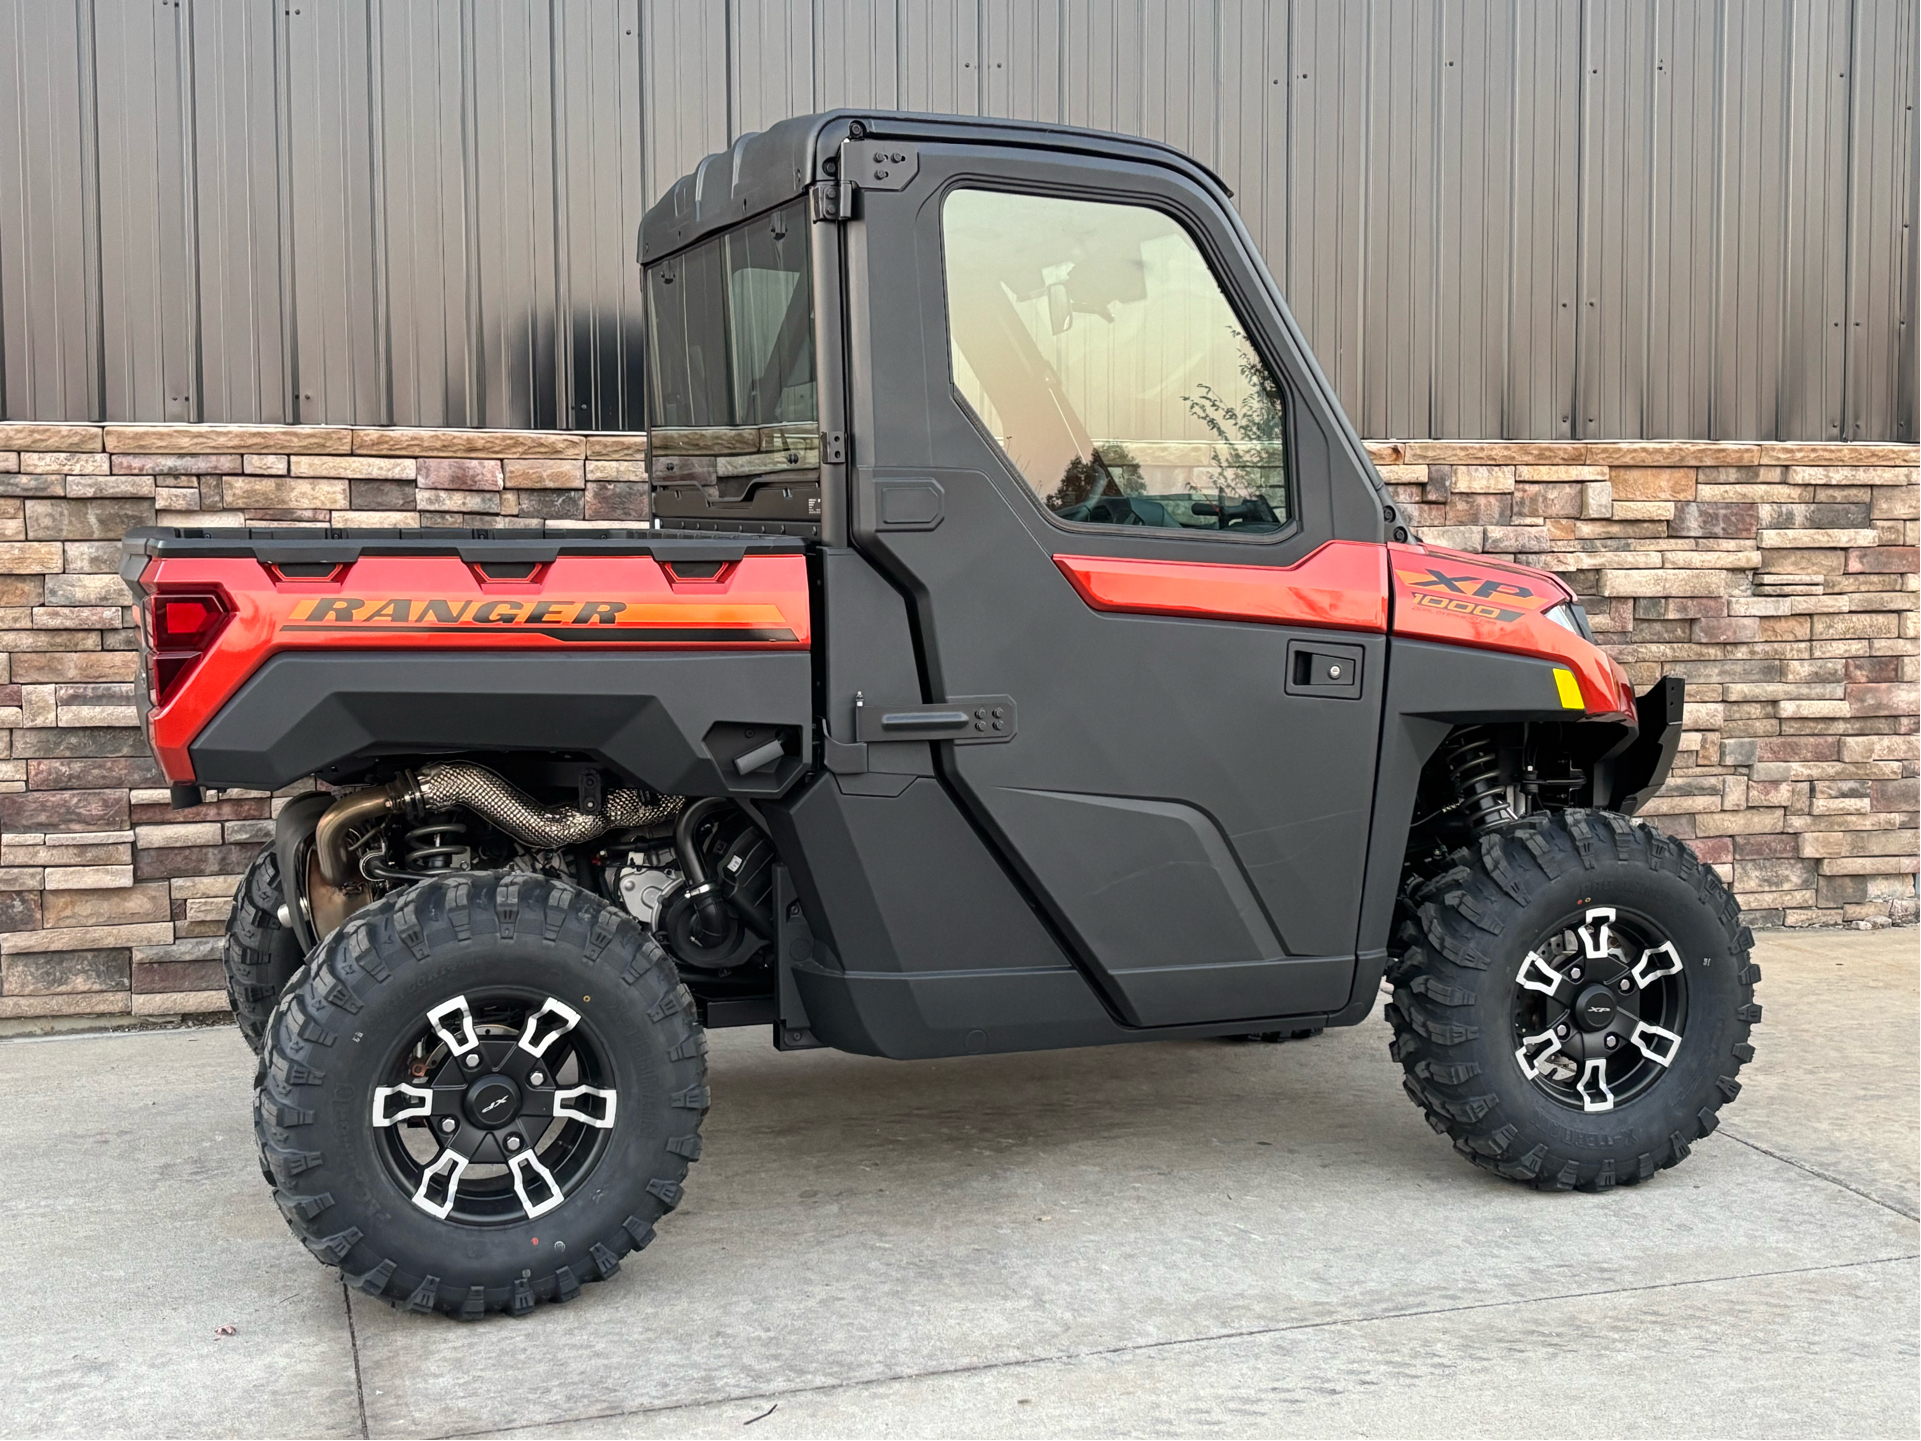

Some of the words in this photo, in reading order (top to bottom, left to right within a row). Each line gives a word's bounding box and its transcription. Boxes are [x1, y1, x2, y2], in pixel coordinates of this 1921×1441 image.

[1408, 568, 1534, 599] XP
[304, 597, 628, 625] RANGER
[1412, 593, 1501, 619] 1000
[481, 1094, 509, 1113] XP
